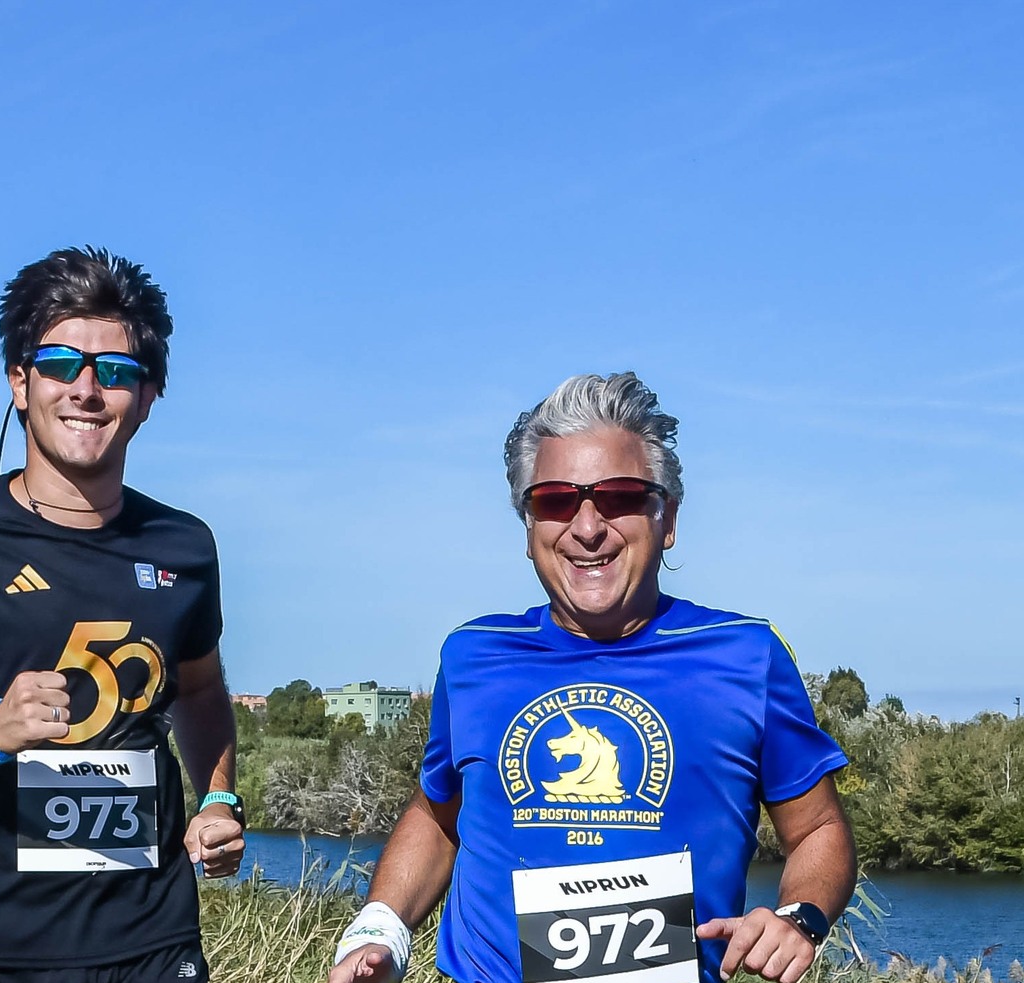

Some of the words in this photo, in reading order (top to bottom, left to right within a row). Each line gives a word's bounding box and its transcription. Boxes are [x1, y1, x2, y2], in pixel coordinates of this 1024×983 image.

[505, 725, 529, 794] BOSTON
[523, 688, 608, 726] ATHLETIC
[610, 693, 667, 796] ASSOCIATION
[59, 763, 131, 777] KIPRUN
[44, 795, 140, 840] 973
[539, 808, 589, 822] BOSTON
[567, 830, 604, 846] 2016
[558, 873, 650, 896] KIPRUN
[547, 908, 670, 971] 972
